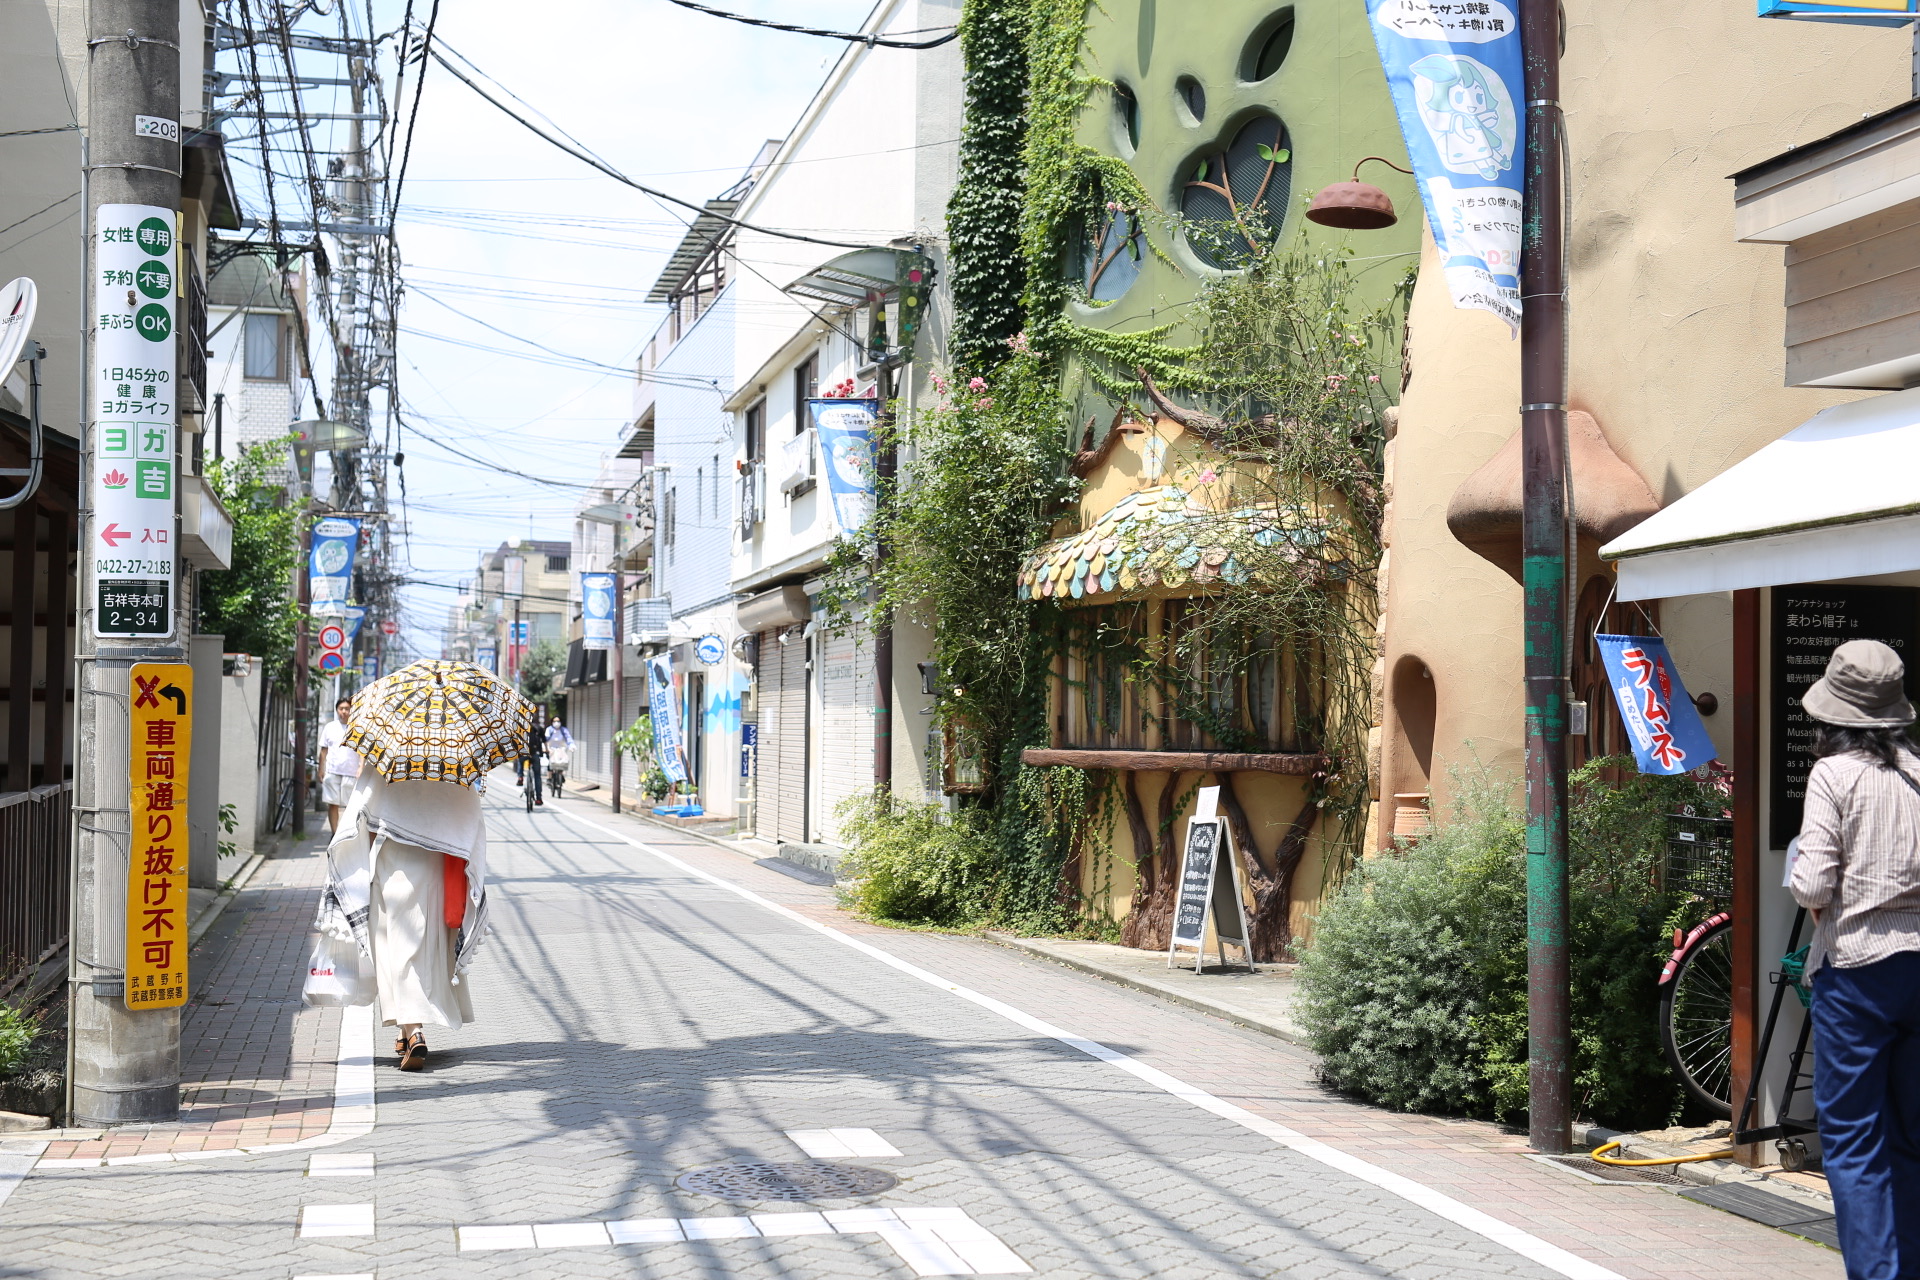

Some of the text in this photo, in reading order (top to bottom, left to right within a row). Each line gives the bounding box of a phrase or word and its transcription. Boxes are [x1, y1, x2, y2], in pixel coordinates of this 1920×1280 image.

[149, 121, 177, 139] 208
[103, 227, 169, 247] 女性 専用
[102, 270, 170, 290] 予約 不要
[100, 314, 167, 332] 手ぶら OK
[103, 368, 169, 383] 1日45分の
[102, 401, 169, 415] ヨガライフ
[142, 466, 167, 493] 吉
[141, 528, 167, 544] 入口
[97, 559, 171, 574] 0422-27-2183
[103, 593, 163, 608] 吉祥寺本町
[1786, 599, 1847, 609] アンテナショップ
[1786, 614, 1847, 629] 麦わら帽子
[325, 632, 340, 645] 30
[1786, 673, 1823, 683] 観光情報
[1621, 647, 1686, 770] ラムネ
[1787, 712, 1803, 721] and
[1787, 727, 1820, 737] Musash
[1787, 789, 1806, 798] thos
[141, 718, 177, 969] 車両通り抜け不可
[131, 971, 183, 988] 武蔵野市
[131, 986, 183, 1003] 武蔵野警察署
